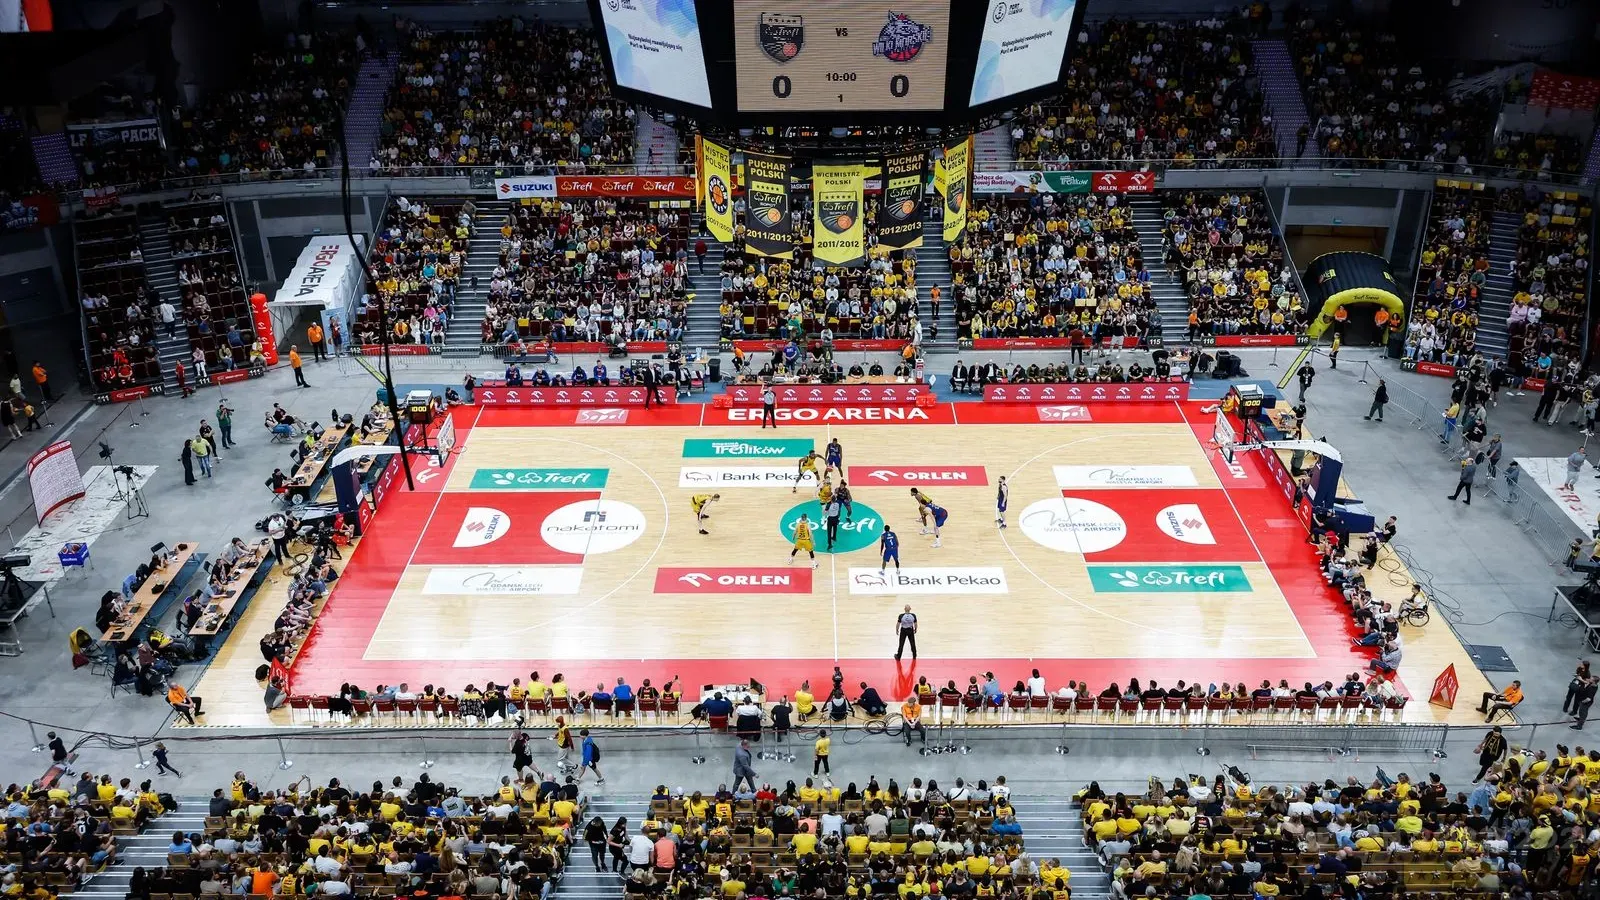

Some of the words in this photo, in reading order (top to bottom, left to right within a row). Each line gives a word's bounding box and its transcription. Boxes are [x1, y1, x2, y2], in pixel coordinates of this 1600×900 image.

[835, 28, 848, 37] VS
[773, 75, 792, 98] 0
[825, 72, 857, 82] 10:00
[890, 74, 909, 98] 0
[837, 94, 843, 102] 1
[120, 127, 157, 142] PACK
[704, 145, 729, 163] MISTRZ
[886, 153, 924, 167] PUCHAR
[705, 155, 729, 172] POLSKI
[748, 159, 786, 172] PUCHAR
[888, 163, 921, 175] POLSKI
[948, 157, 966, 170] POLSK
[751, 168, 784, 179] POLSKI
[512, 183, 553, 192] SUZUKI
[572, 181, 593, 192] Trefl
[612, 181, 634, 192] Trefl
[654, 181, 675, 192] Trefl
[899, 185, 917, 197] Trefl
[763, 193, 783, 204] Trefl
[833, 202, 854, 212] Trefl
[879, 222, 922, 235] 2012/2013
[747, 229, 792, 243] 2011/2012
[817, 240, 859, 248] 2011/2012
[581, 409, 625, 423] Sopot
[727, 408, 819, 421] ERGO
[822, 407, 929, 420] ARENA
[1041, 406, 1085, 421] Sopot
[712, 443, 786, 455] Treflików
[543, 472, 591, 485] Trefl
[722, 473, 760, 481] Bank
[903, 471, 967, 481] ORLEN
[484, 514, 501, 540] SUZUKI
[546, 524, 639, 532] nakatomi
[820, 517, 876, 533] Tefl
[1166, 511, 1184, 537] SUZUKI
[717, 575, 790, 586] ORLEN
[897, 575, 942, 587] Bank
[947, 575, 1001, 587] Pekao
[1171, 571, 1225, 587] Trefl
